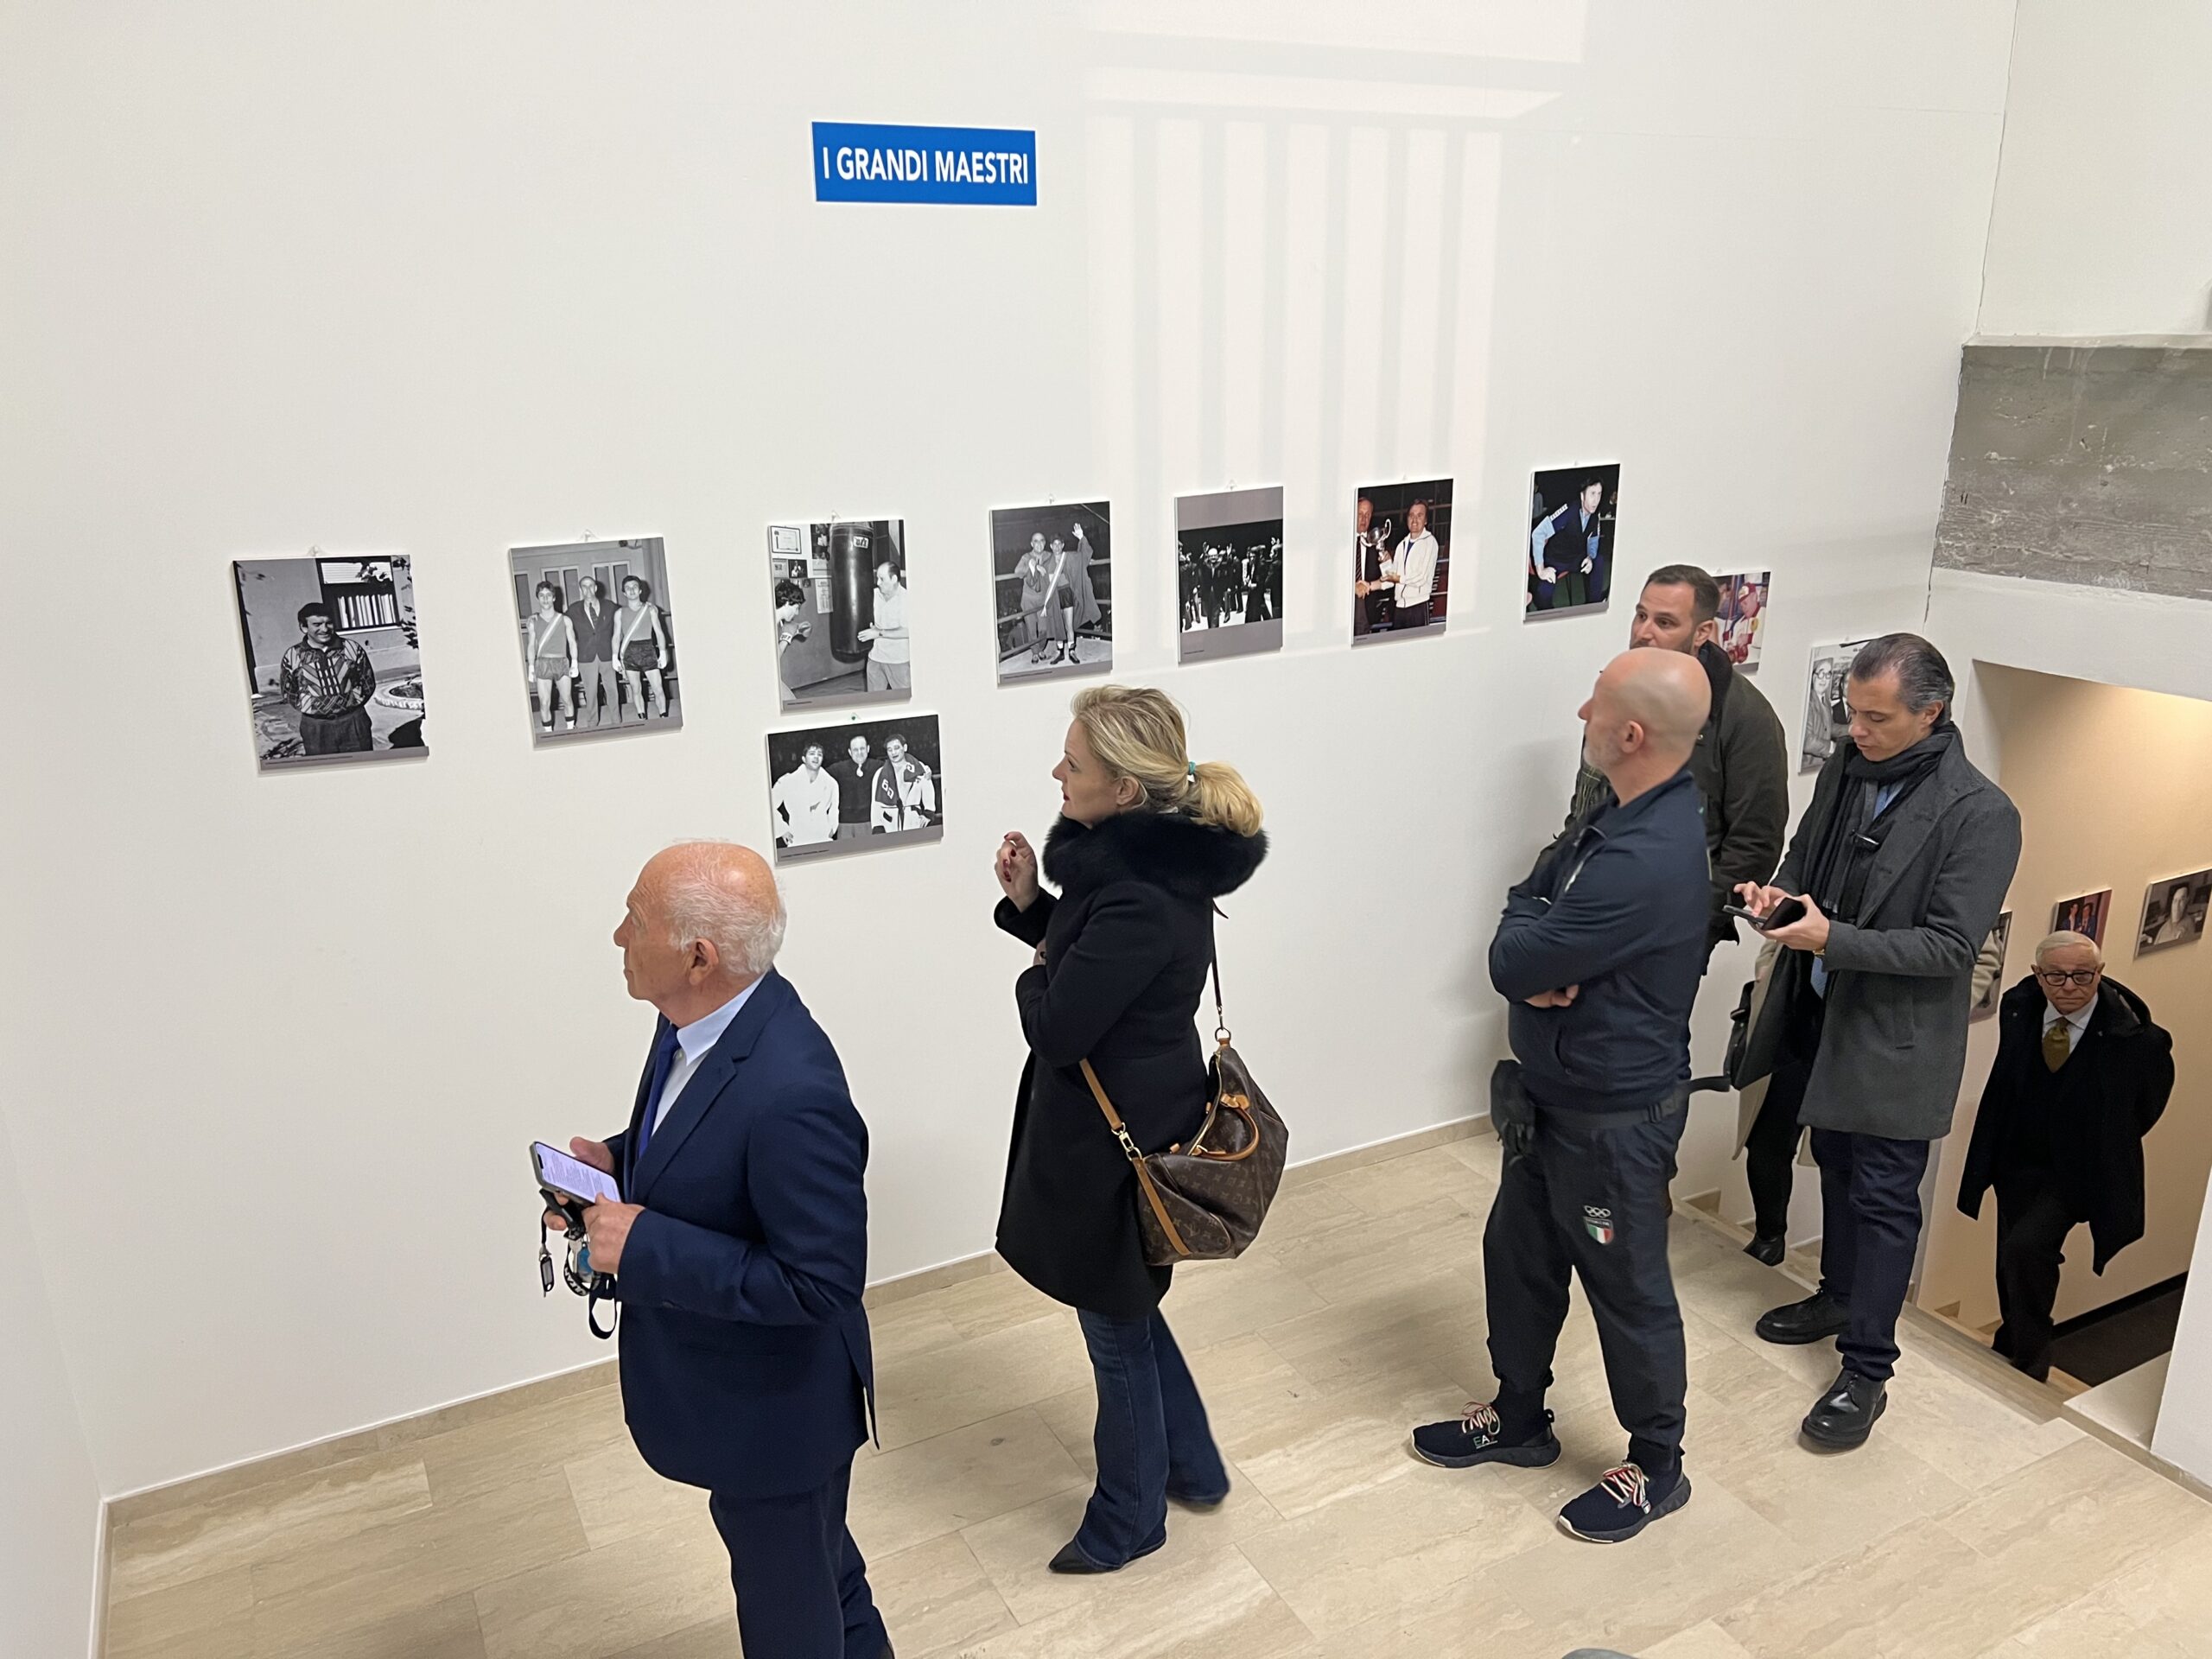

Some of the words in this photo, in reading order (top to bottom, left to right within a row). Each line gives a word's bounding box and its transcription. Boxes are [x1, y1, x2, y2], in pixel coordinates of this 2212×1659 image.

[823, 146, 830, 179] I
[836, 146, 928, 181] GRANDI
[935, 150, 1028, 184] MAESTRI
